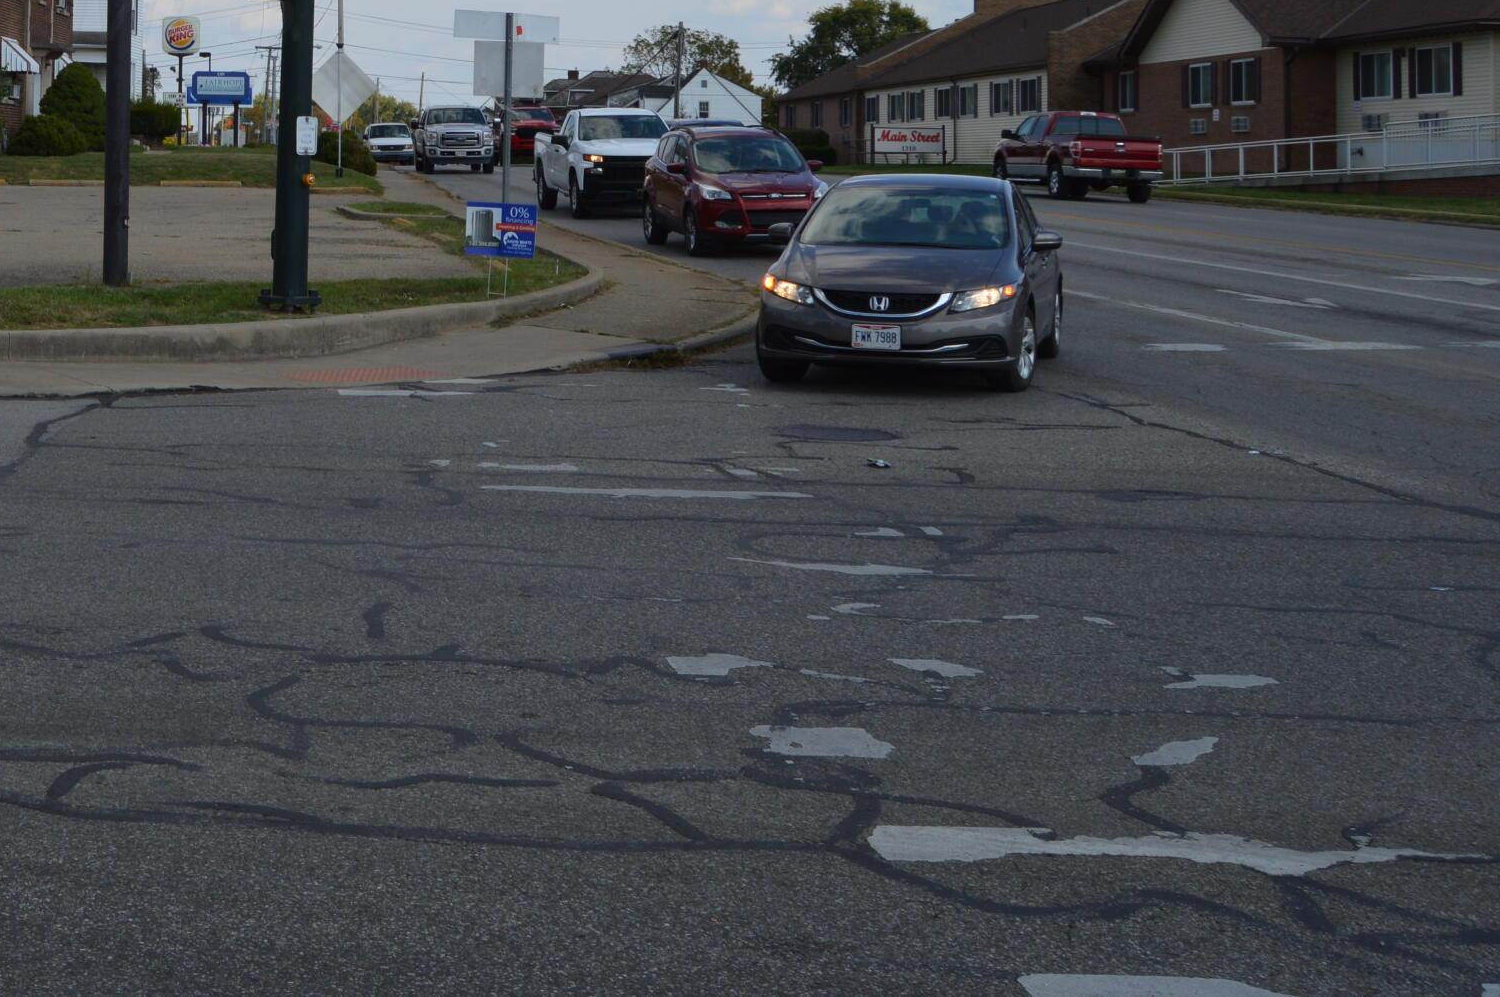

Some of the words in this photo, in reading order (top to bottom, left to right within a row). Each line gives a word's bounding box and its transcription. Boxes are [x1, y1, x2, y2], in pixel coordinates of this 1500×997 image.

[168, 24, 193, 36] BURGER
[169, 30, 194, 44] KING
[877, 129, 908, 142] Main
[910, 130, 941, 143] Street
[510, 206, 530, 219] 0%
[505, 216, 534, 225] financing
[875, 331, 897, 344] 7988
